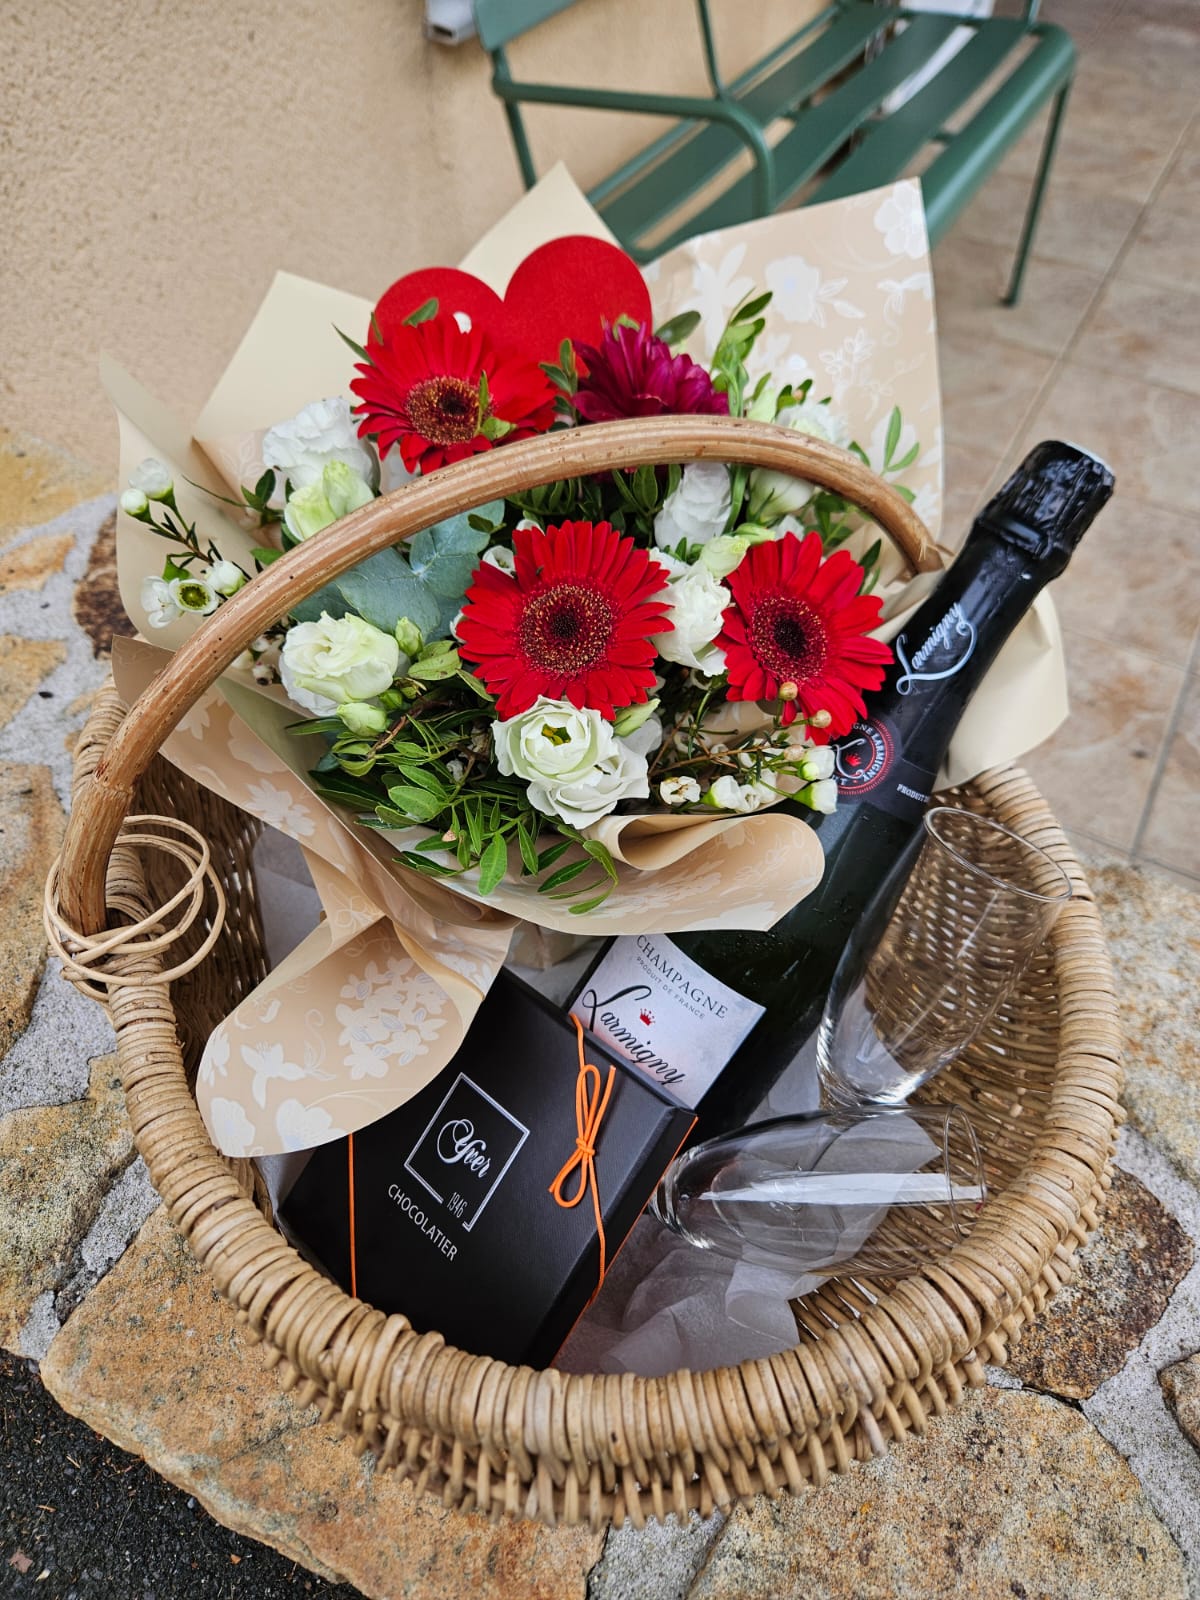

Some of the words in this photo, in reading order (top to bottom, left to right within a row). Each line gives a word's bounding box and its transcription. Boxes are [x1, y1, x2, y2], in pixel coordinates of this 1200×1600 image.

[636, 934, 728, 1019] CHAMPAGNE
[636, 956, 662, 983] PRODUIT
[662, 984, 673, 995] DE
[674, 993, 706, 1020] FRANCE
[582, 984, 685, 1085] Larmigny
[388, 1184, 459, 1261] CHOCOLATIER
[447, 1191, 468, 1219] 1946
